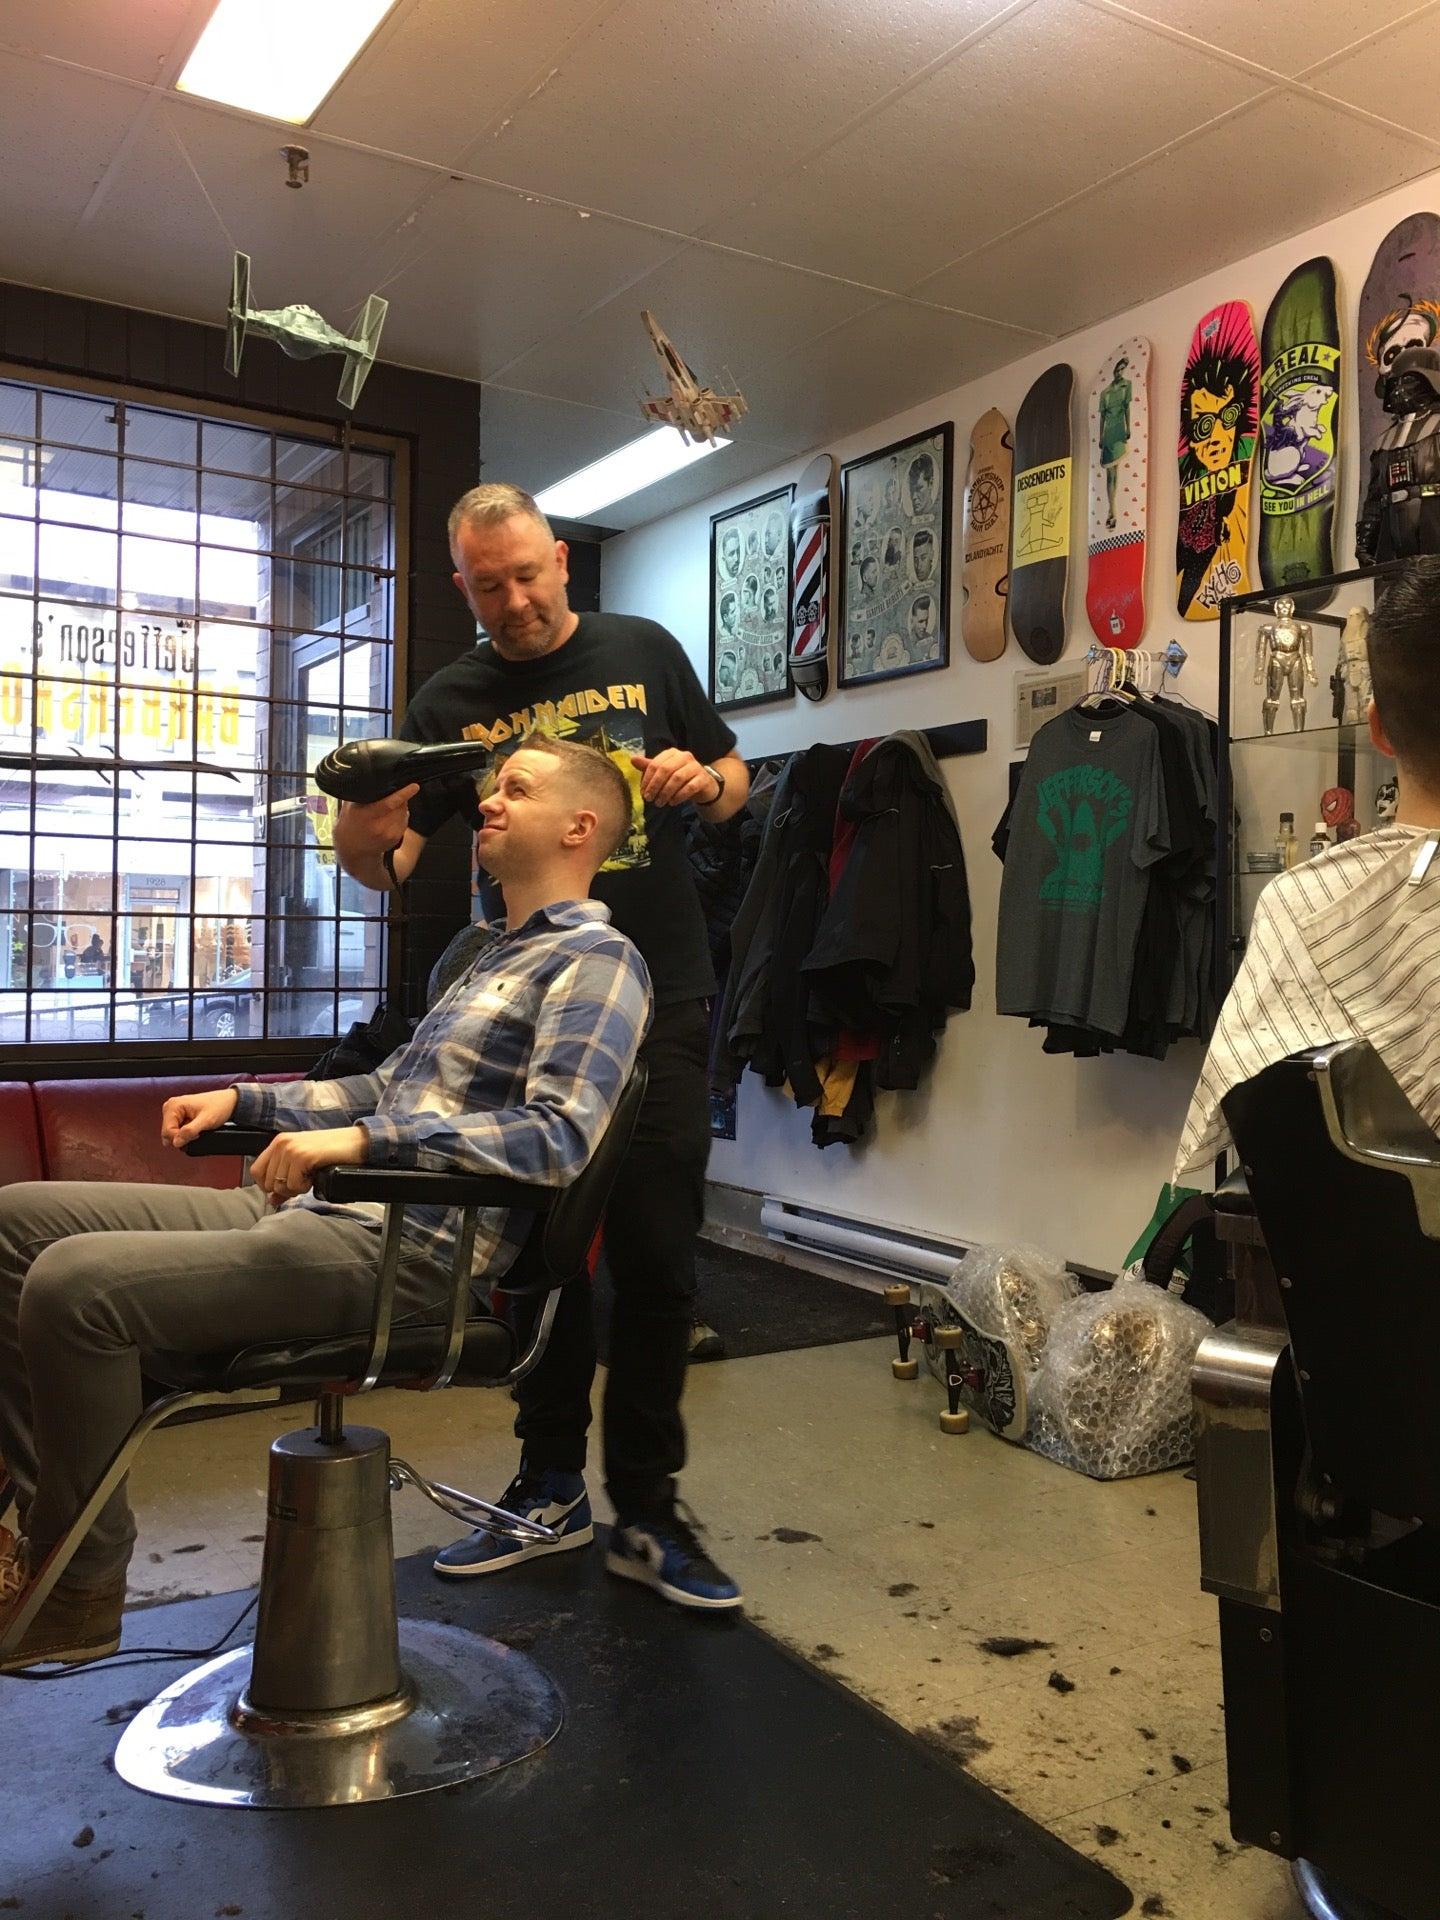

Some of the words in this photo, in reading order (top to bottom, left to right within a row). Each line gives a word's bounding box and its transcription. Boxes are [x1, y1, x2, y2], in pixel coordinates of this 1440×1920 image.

[1274, 345, 1320, 377] REAL
[1017, 464, 1065, 492] DESCENDENTS
[1184, 463, 1242, 506] VISION
[1263, 501, 1276, 512] SEE
[1278, 501, 1294, 511] YOU
[1296, 496, 1305, 508] IN
[1307, 484, 1329, 504] HELL
[1197, 561, 1242, 609] PSYCHO
[462, 709, 532, 751] IRON
[533, 684, 648, 725] MAIDEN
[145, 877, 166, 886] 1928
